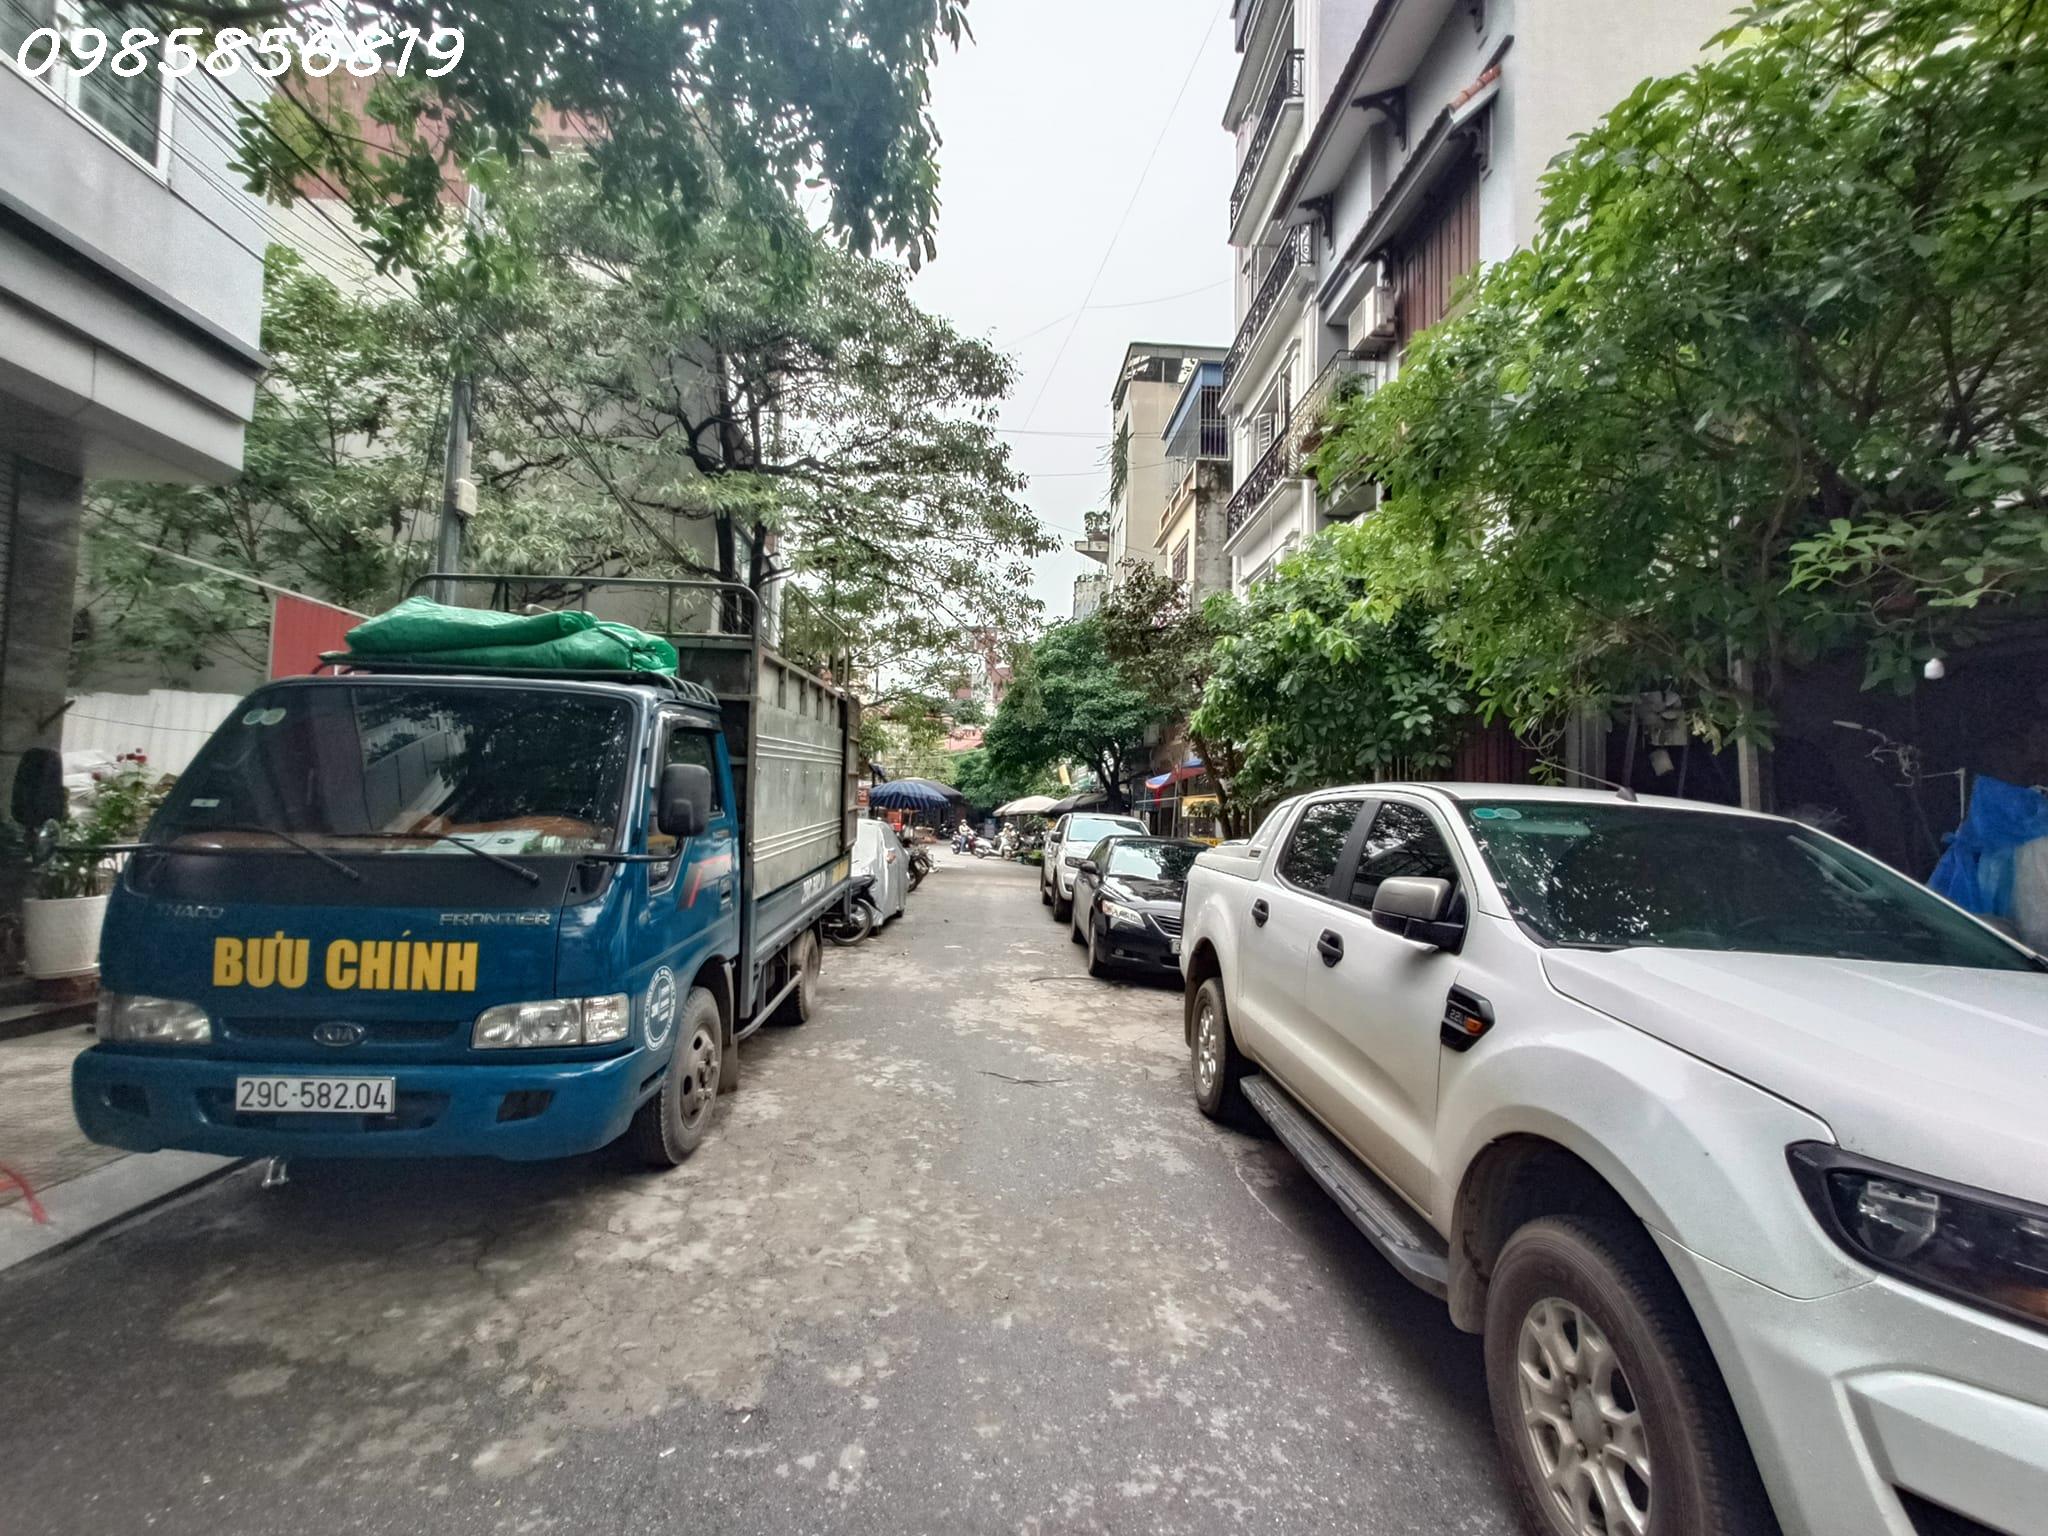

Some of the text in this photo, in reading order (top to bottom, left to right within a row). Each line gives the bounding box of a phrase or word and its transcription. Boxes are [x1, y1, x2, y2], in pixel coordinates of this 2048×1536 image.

[439, 912, 551, 926] FRONTIER
[213, 930, 479, 992] BƯU CHÍNH
[240, 1080, 387, 1110] 29C-582.04
